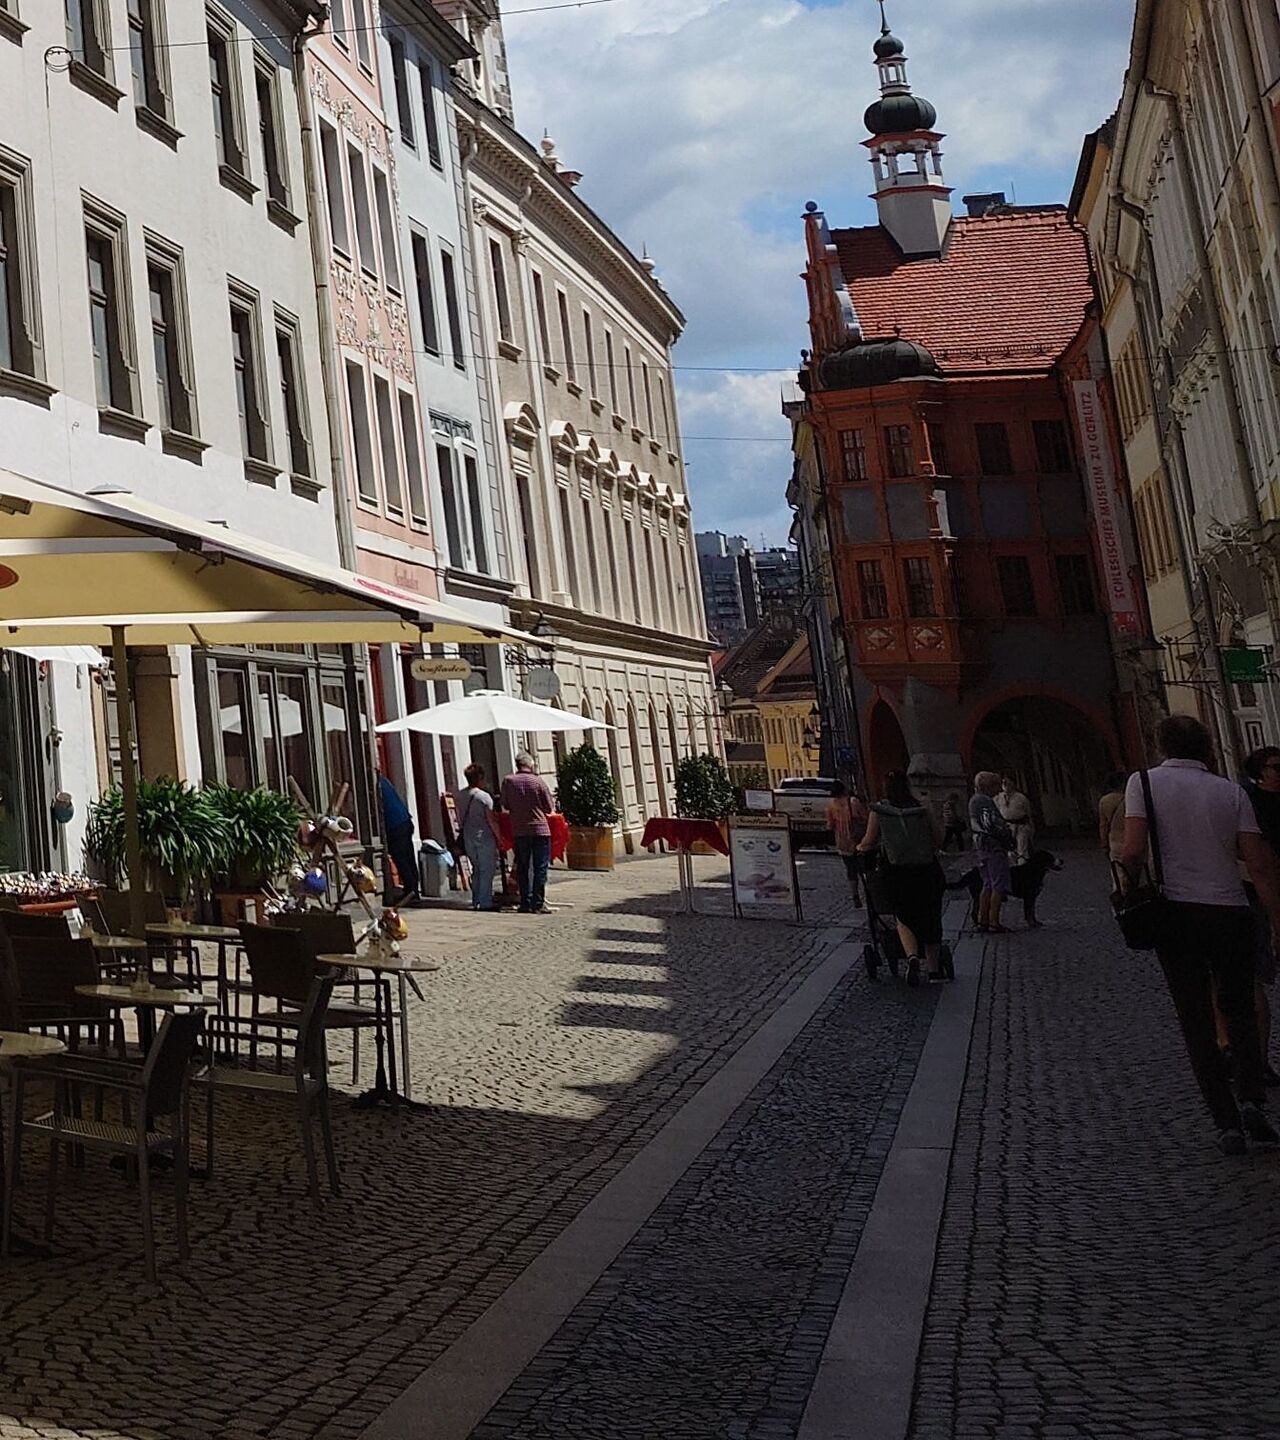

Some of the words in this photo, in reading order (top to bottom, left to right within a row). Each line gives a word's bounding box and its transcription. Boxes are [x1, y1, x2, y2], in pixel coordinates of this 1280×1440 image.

[1090, 445, 1101, 460] ZU
[1091, 466, 1113, 517] MUSEUM
[1102, 516, 1125, 599] SCHLESISCHES
